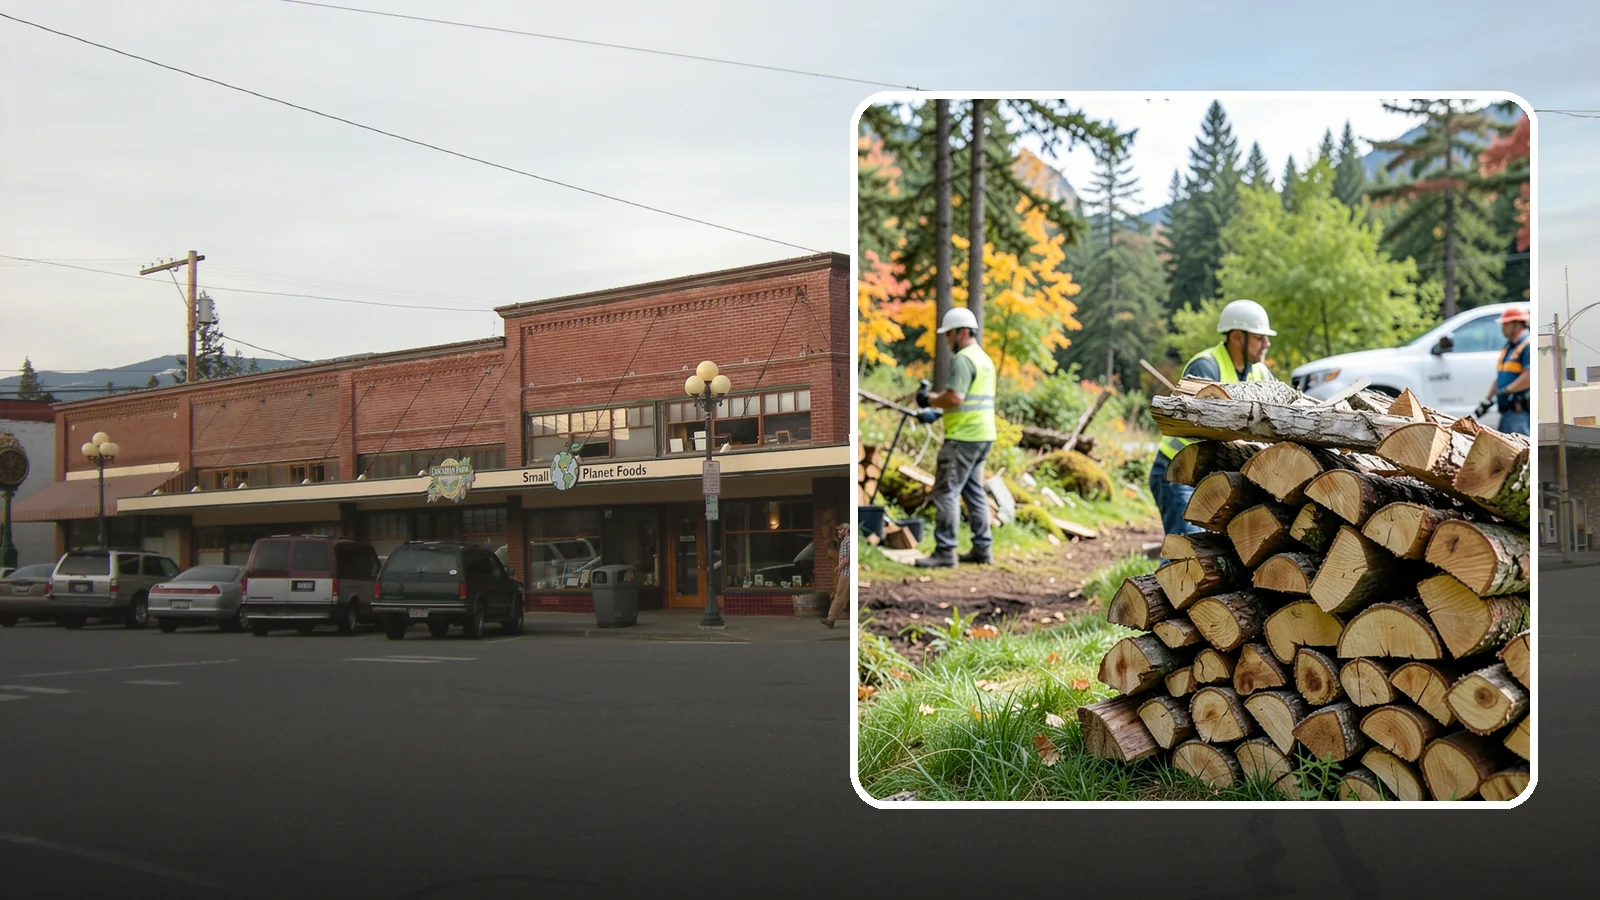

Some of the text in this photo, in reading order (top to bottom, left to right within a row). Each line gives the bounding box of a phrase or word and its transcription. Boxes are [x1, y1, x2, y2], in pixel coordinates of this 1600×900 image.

[523, 464, 647, 483] Small Planet Foods
